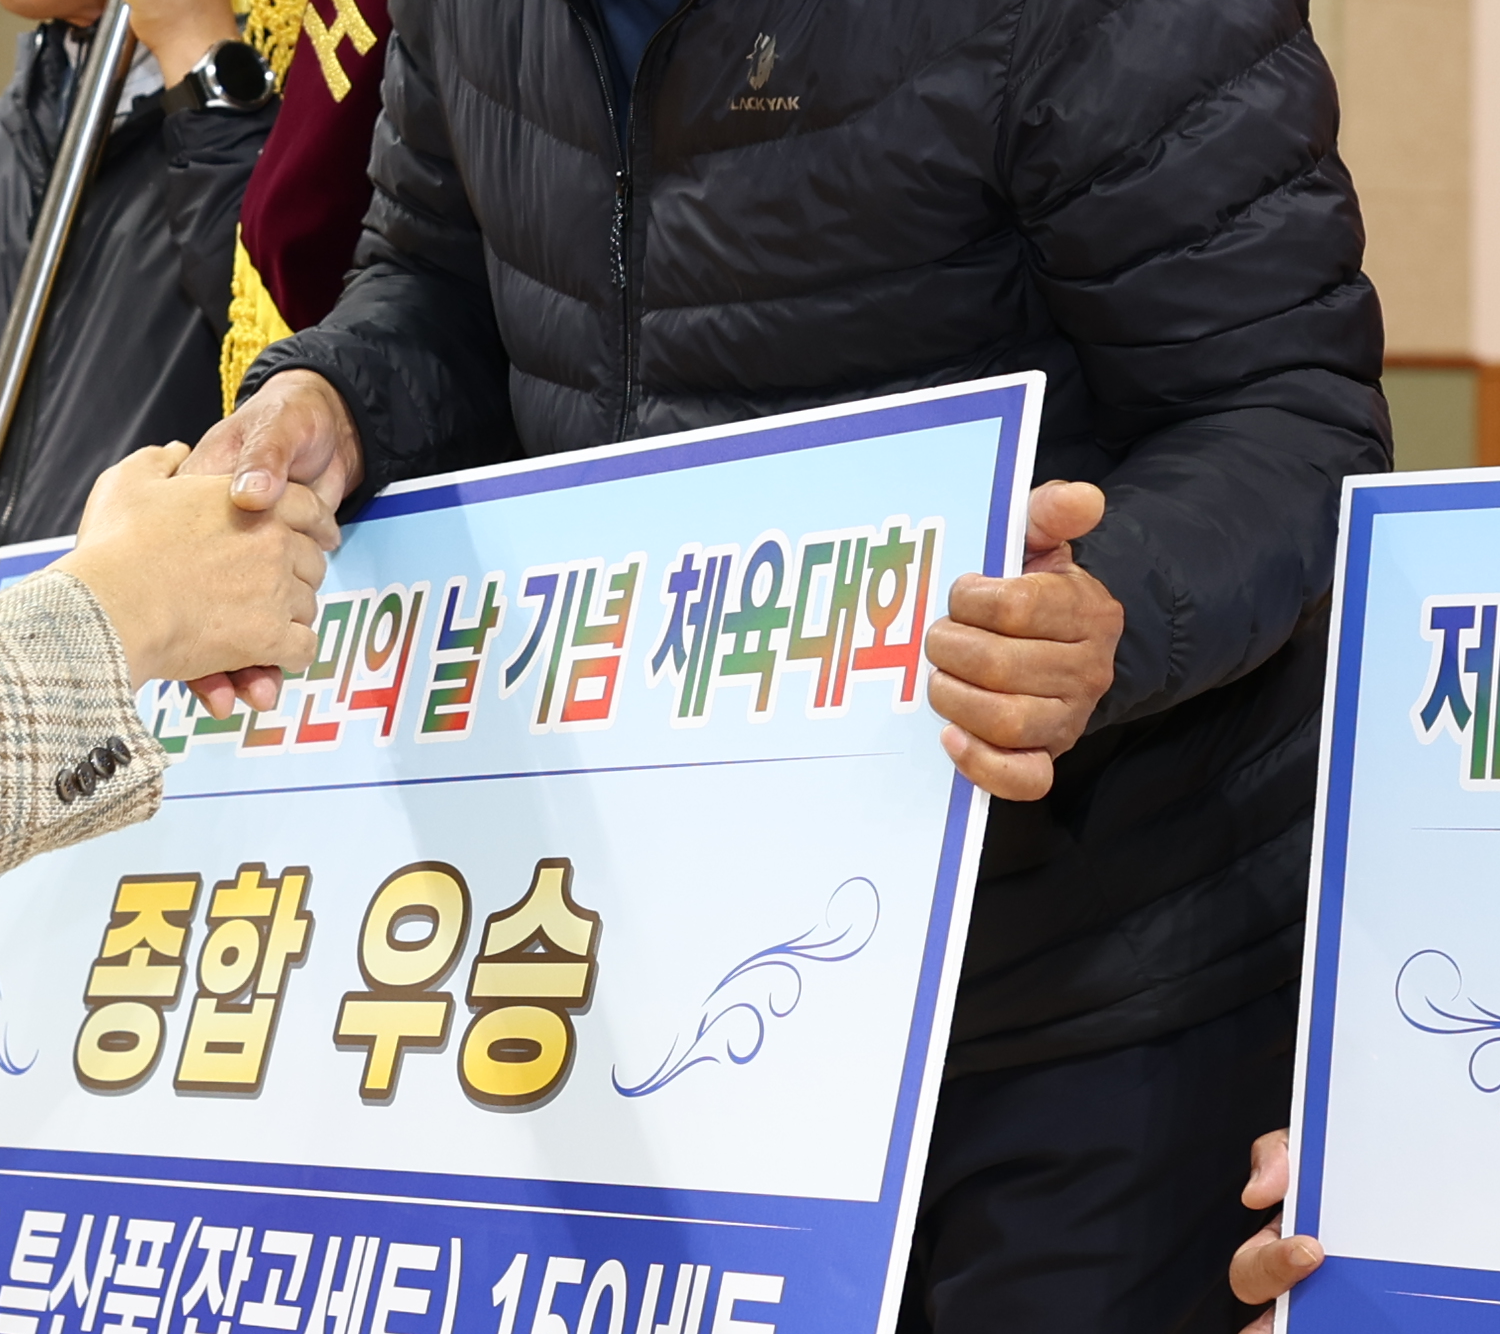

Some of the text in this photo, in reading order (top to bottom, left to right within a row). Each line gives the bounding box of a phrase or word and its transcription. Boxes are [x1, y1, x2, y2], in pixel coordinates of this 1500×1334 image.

[727, 96, 800, 111] LACKYAK
[421, 581, 500, 733] 날
[505, 562, 641, 725] 기념
[652, 524, 936, 719] 체육대회
[74, 857, 602, 1112] 종합 우승
